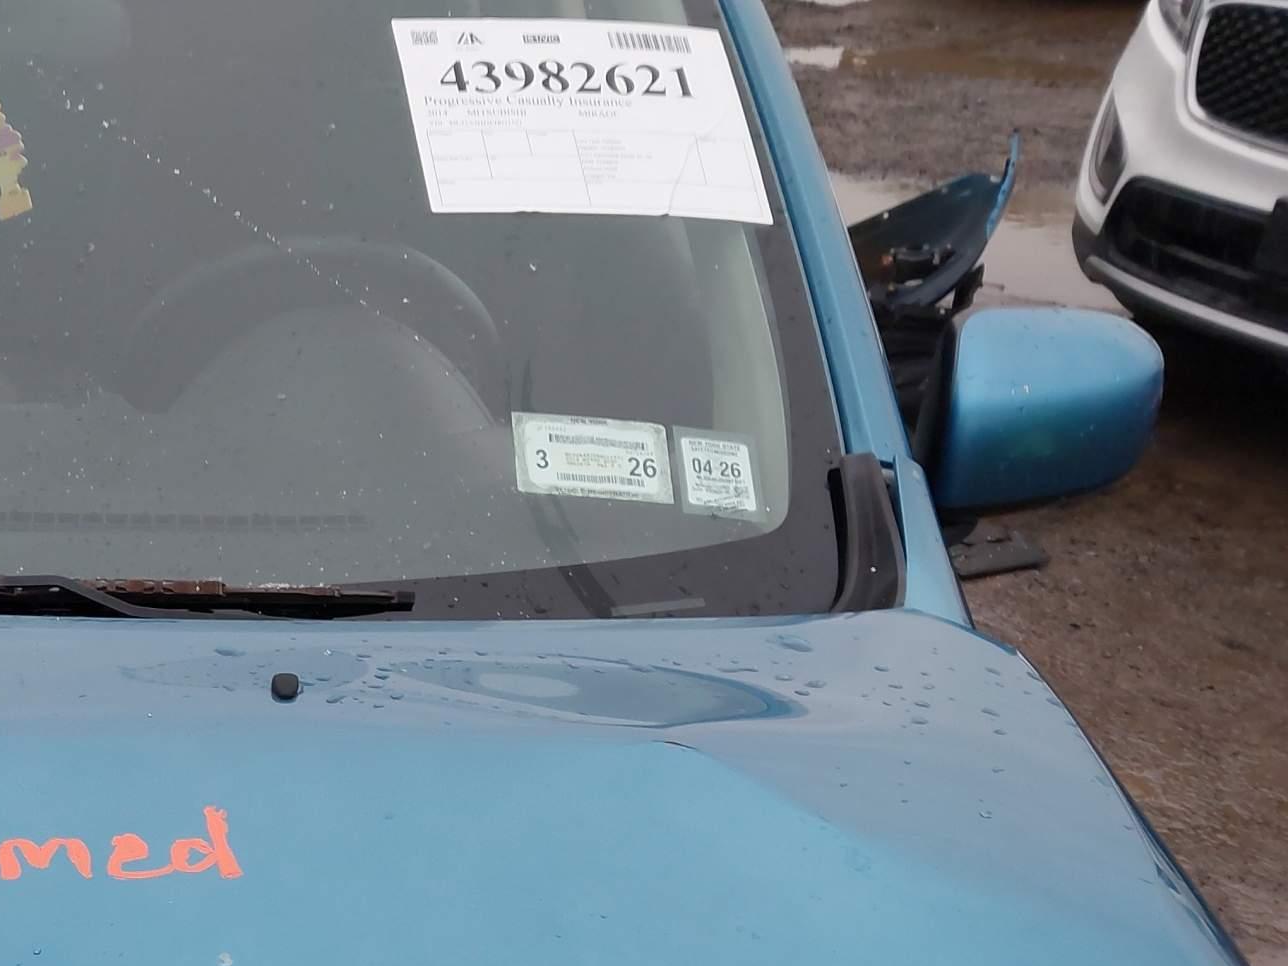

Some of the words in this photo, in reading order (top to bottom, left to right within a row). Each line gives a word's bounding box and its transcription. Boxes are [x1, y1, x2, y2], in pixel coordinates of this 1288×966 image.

[440, 58, 696, 98] 43982621
[424, 95, 503, 108] Progressive
[506, 95, 564, 108] Casualty
[569, 96, 633, 108] Insurance
[535, 449, 549, 469] 3
[627, 457, 657, 478] 26
[692, 457, 713, 475] 04
[719, 461, 741, 478] 26
